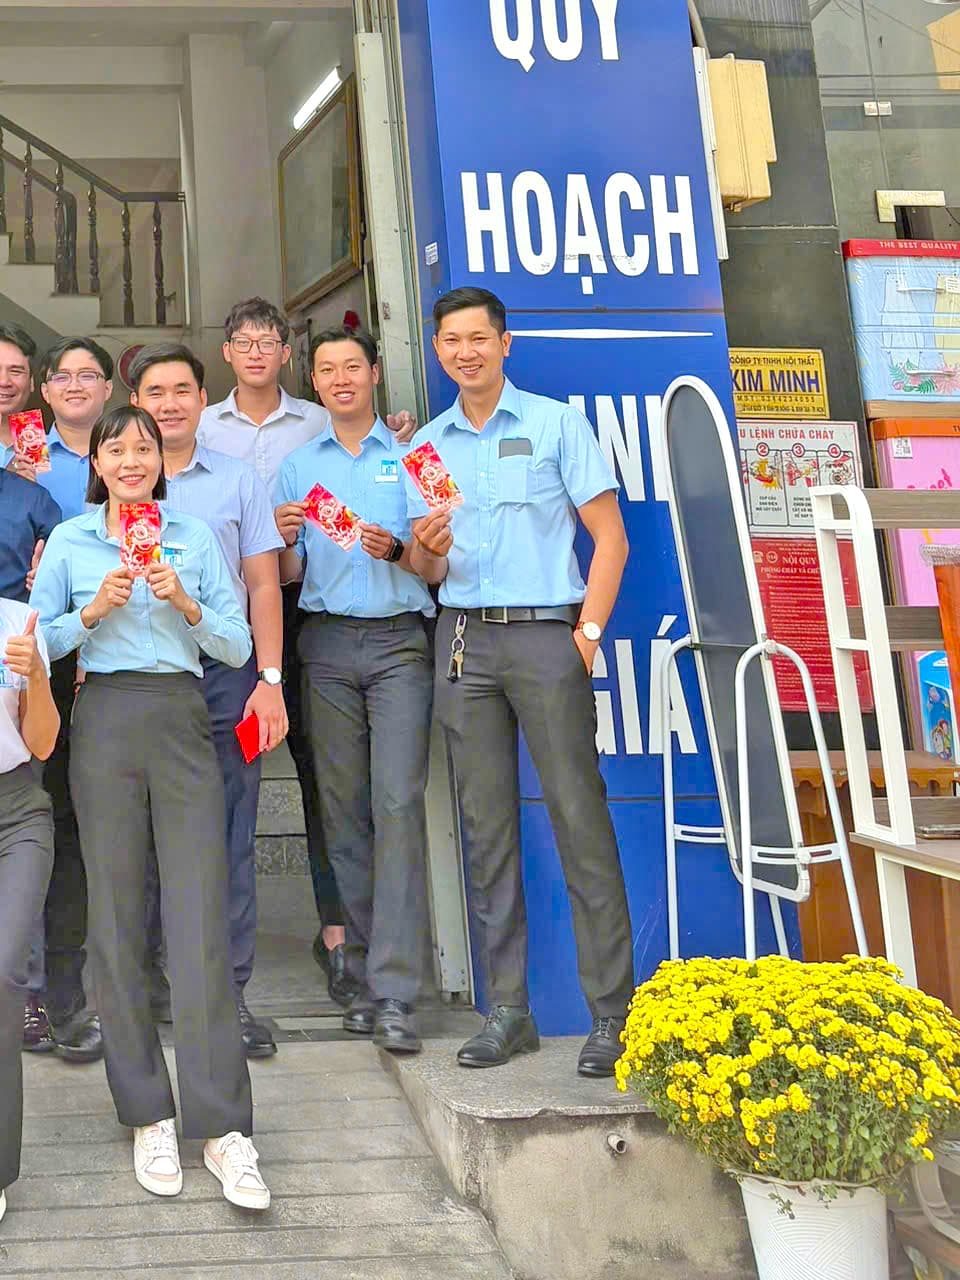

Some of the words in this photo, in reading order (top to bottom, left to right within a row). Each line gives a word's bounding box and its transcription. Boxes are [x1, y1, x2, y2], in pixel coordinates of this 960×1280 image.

[460, 170, 700, 295] HOẠCH
[879, 241, 895, 249] THE
[898, 241, 918, 250] BEST
[921, 242, 958, 251] QUALITY
[732, 368, 764, 392] KIM
[769, 369, 820, 393] MINH
[759, 444, 767, 454] 2
[794, 445, 802, 455] 3
[830, 447, 838, 455] 4
